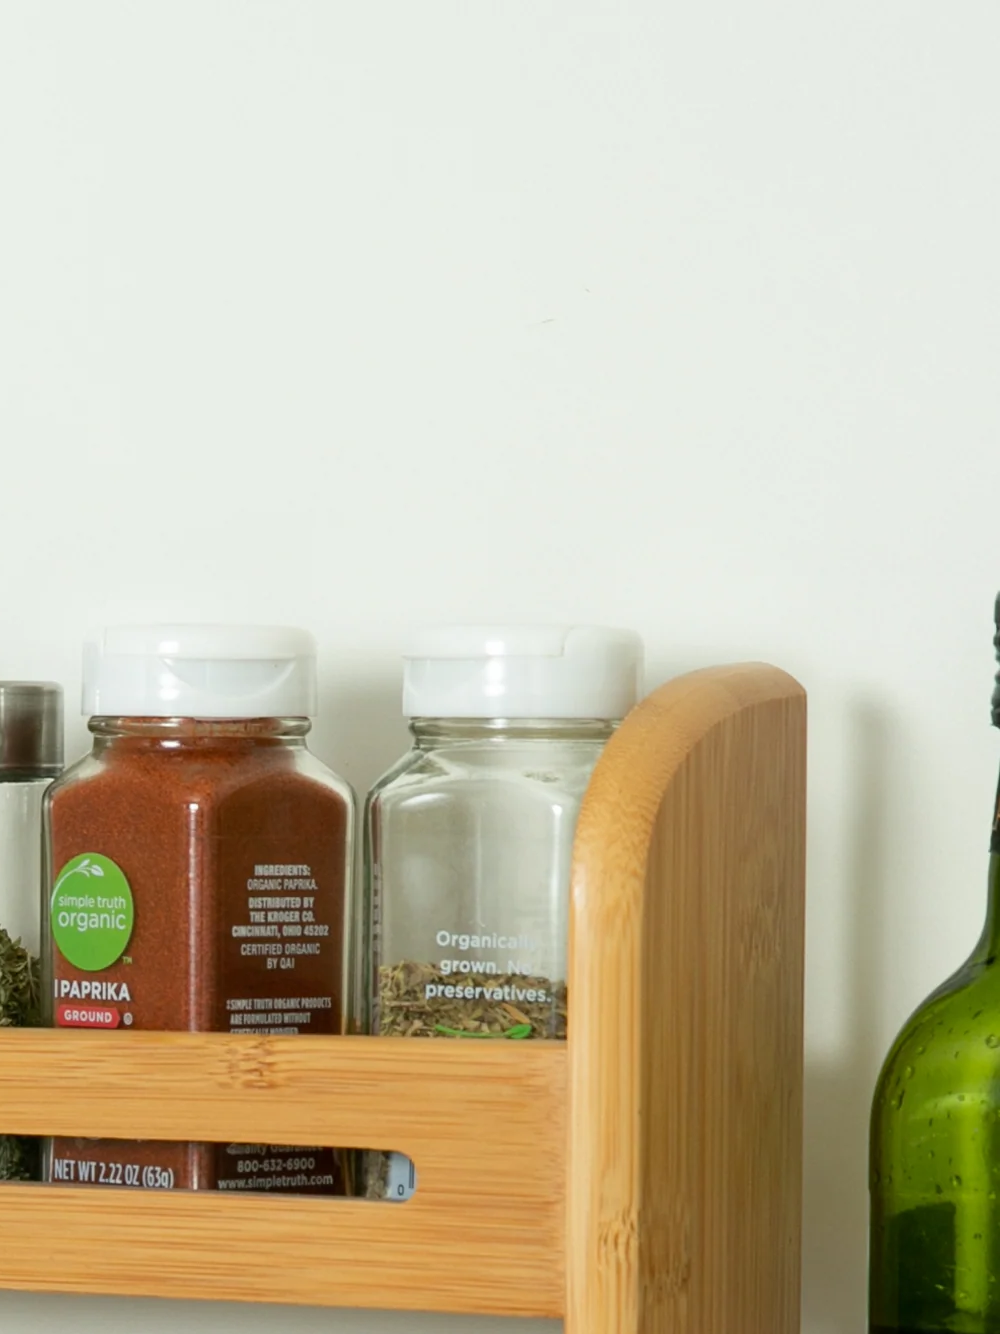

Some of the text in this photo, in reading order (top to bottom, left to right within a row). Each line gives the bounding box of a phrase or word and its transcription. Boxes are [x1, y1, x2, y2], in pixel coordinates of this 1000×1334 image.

[254, 865, 311, 876] INGREDIENTS:
[247, 879, 282, 890] ORGANIC
[58, 894, 126, 909] simple truth
[248, 897, 315, 909] DISTRIBUTED BY
[58, 910, 126, 932] organic
[250, 911, 315, 923] THE KROGER CO.
[232, 925, 329, 939] CINCINNATI, OHIO 45202
[241, 943, 320, 955] CERTIFIED ORGANIC
[266, 958, 295, 969] BY QAI
[440, 959, 532, 976] grown. No
[60, 979, 131, 1001] PAPRIKA
[425, 983, 552, 1002] preservatives.
[301, 997, 332, 1009] PRODUCTS
[64, 1009, 113, 1023] GROUND
[230, 1013, 242, 1025] ARE
[54, 1158, 76, 1180] NET
[78, 1160, 97, 1182] WT
[99, 1161, 122, 1184] 2.22
[125, 1163, 140, 1186] OZ
[237, 1158, 315, 1172] 800-632-6900
[218, 1174, 333, 1190] www.simpletruth.com
